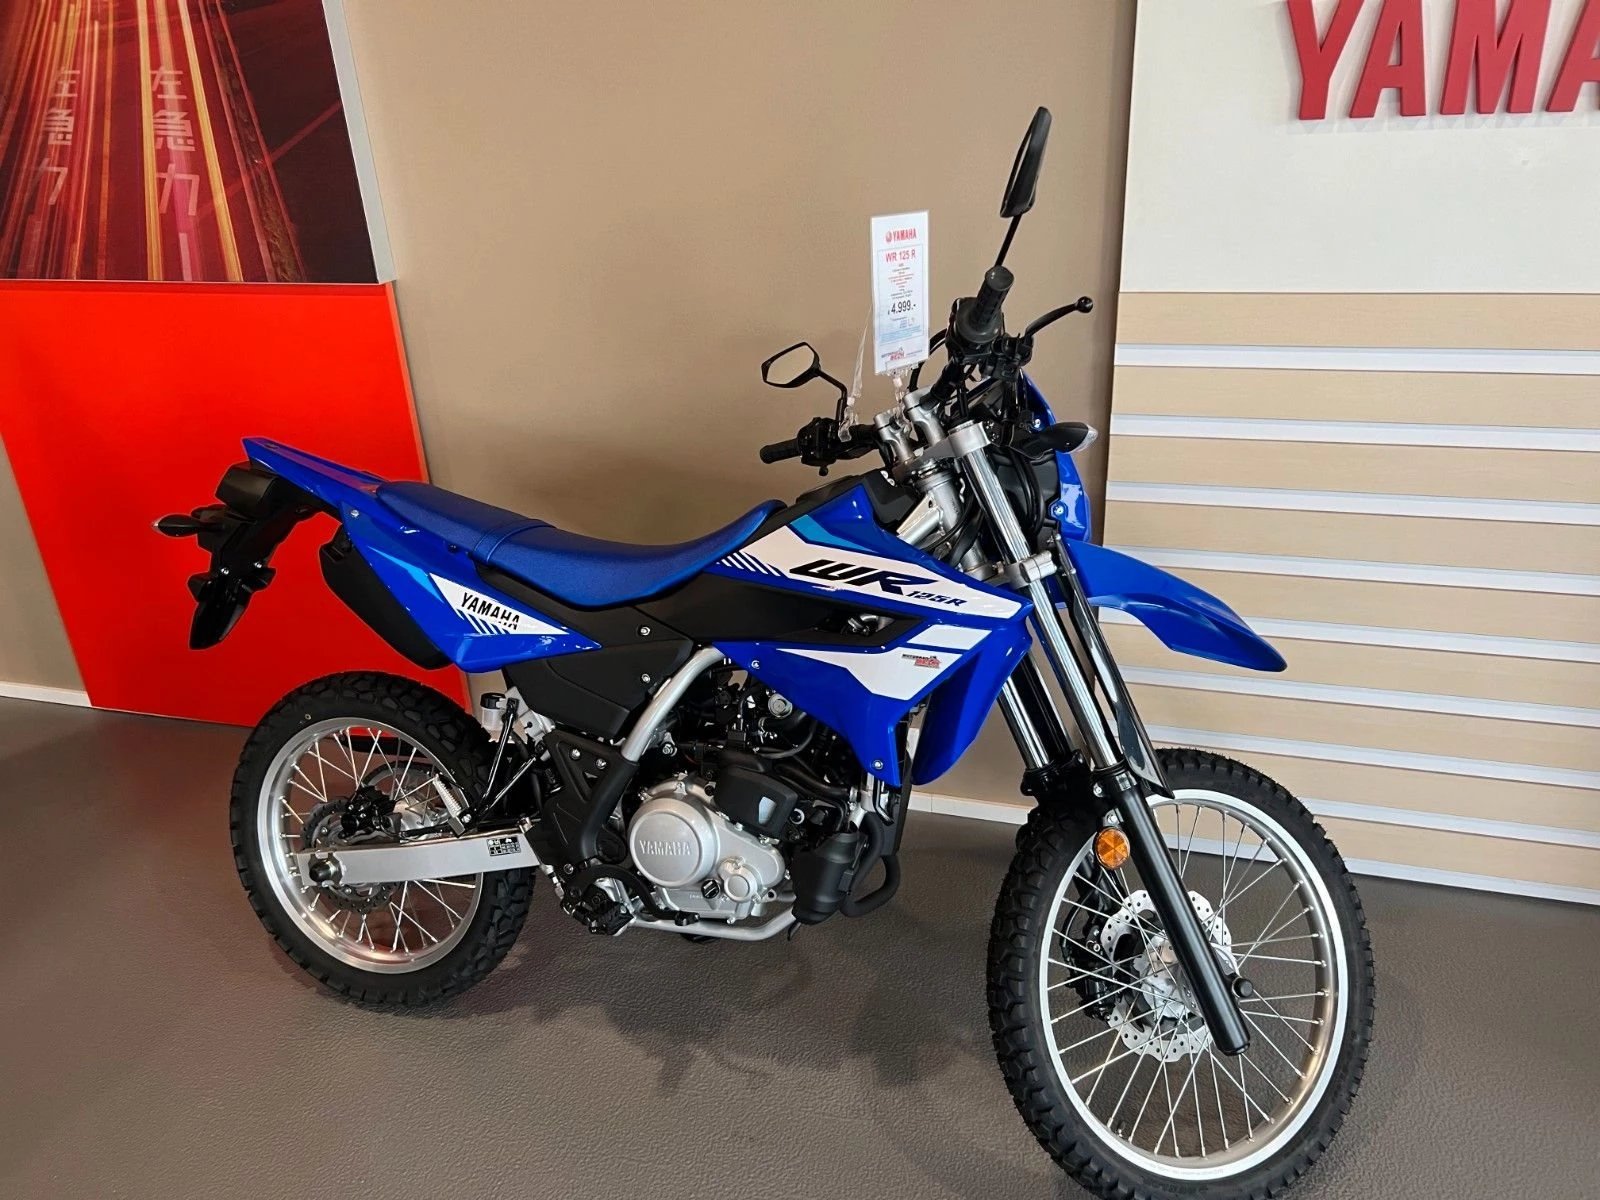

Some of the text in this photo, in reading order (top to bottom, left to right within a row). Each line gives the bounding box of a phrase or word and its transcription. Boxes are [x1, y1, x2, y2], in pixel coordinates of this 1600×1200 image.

[893, 228, 917, 241] YAMAHA
[886, 249, 917, 263] WR 125 R
[789, 559, 939, 595] WR
[907, 590, 968, 607] 125R
[461, 592, 521, 630] YAMAHA
[639, 839, 692, 856] YAMAHA
